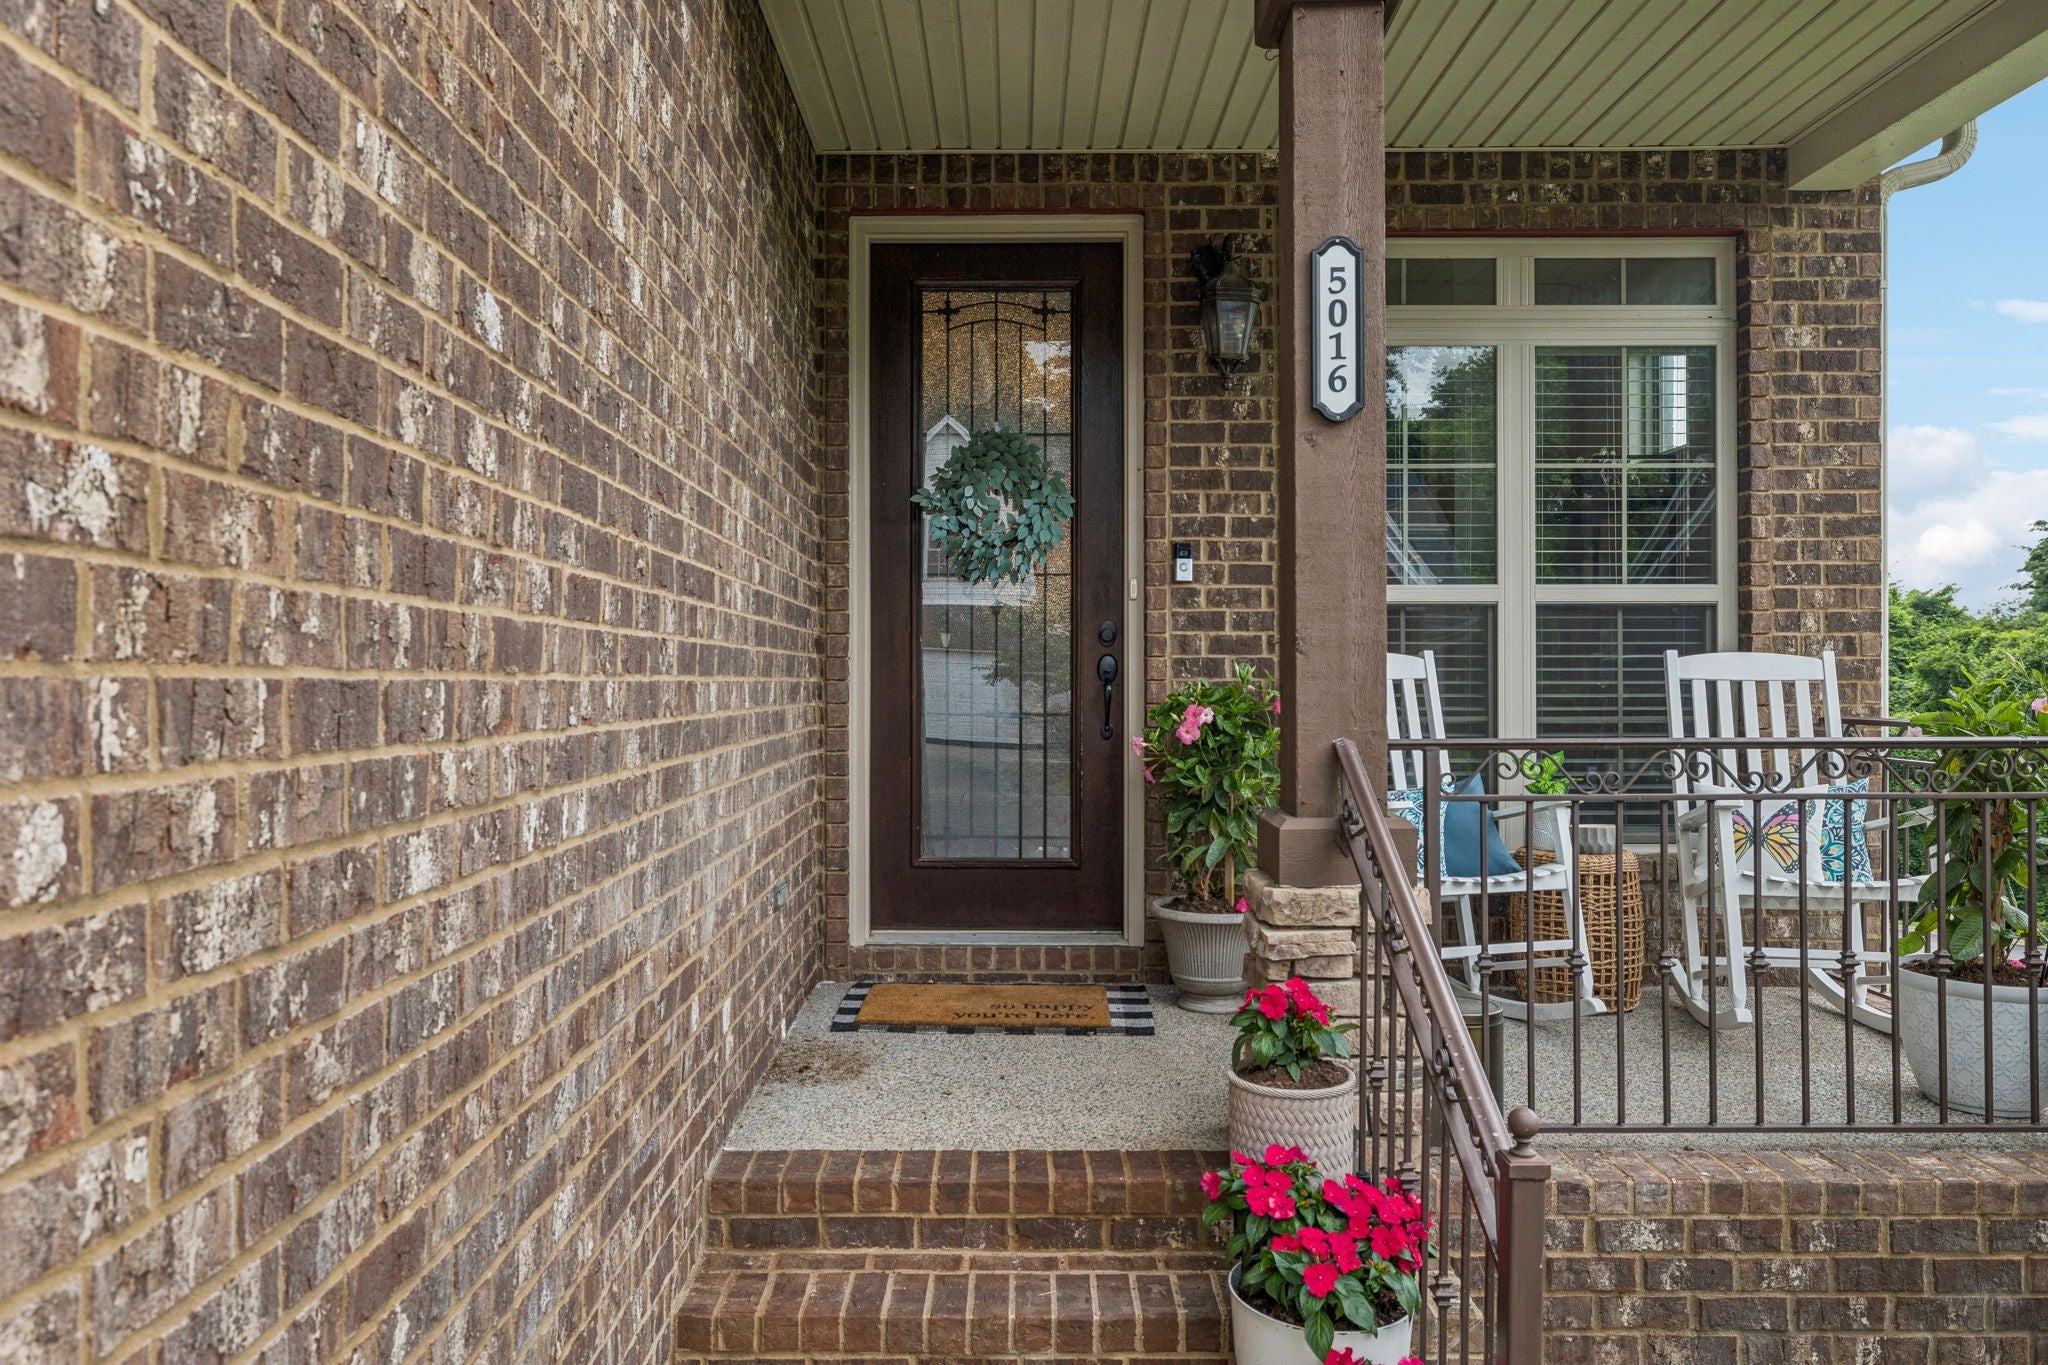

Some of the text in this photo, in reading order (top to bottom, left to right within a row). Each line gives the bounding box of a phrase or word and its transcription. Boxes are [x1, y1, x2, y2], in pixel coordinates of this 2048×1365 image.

[1327, 266, 1348, 393] 5016
[989, 1002, 1097, 1012] so happy
[951, 1011, 1096, 1020] you're here.
